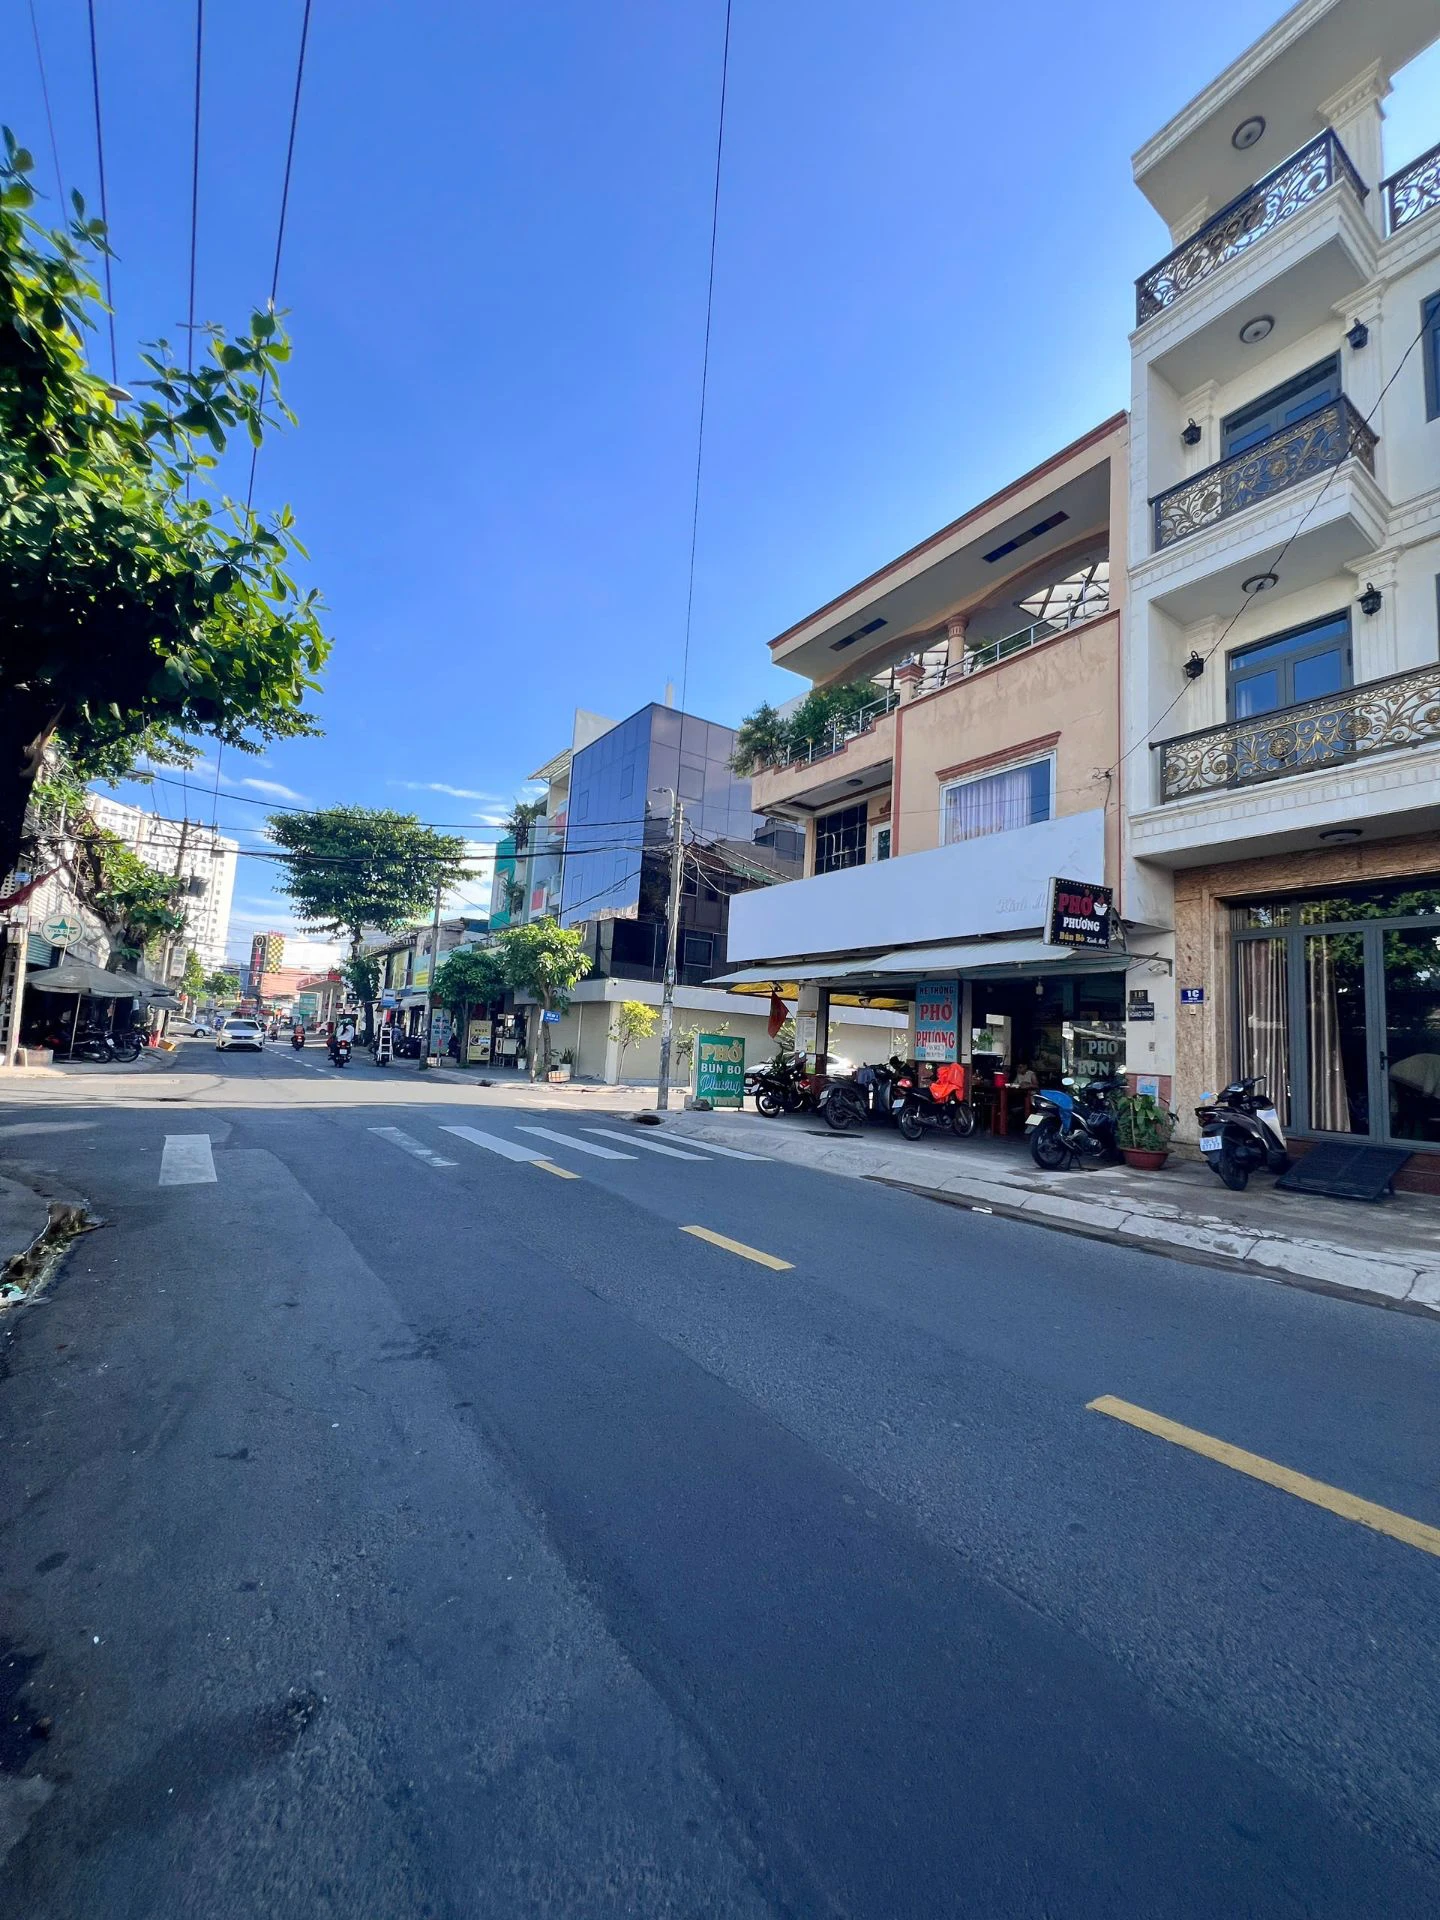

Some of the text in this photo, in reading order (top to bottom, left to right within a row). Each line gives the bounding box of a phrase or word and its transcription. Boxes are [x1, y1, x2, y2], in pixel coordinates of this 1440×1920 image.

[1057, 888, 1093, 916] PHỞ
[1063, 917, 1100, 932] PHƯƠNG
[1186, 989, 1200, 998] 1C
[919, 997, 953, 1022] PHỞ
[701, 1040, 742, 1063] PHỞ
